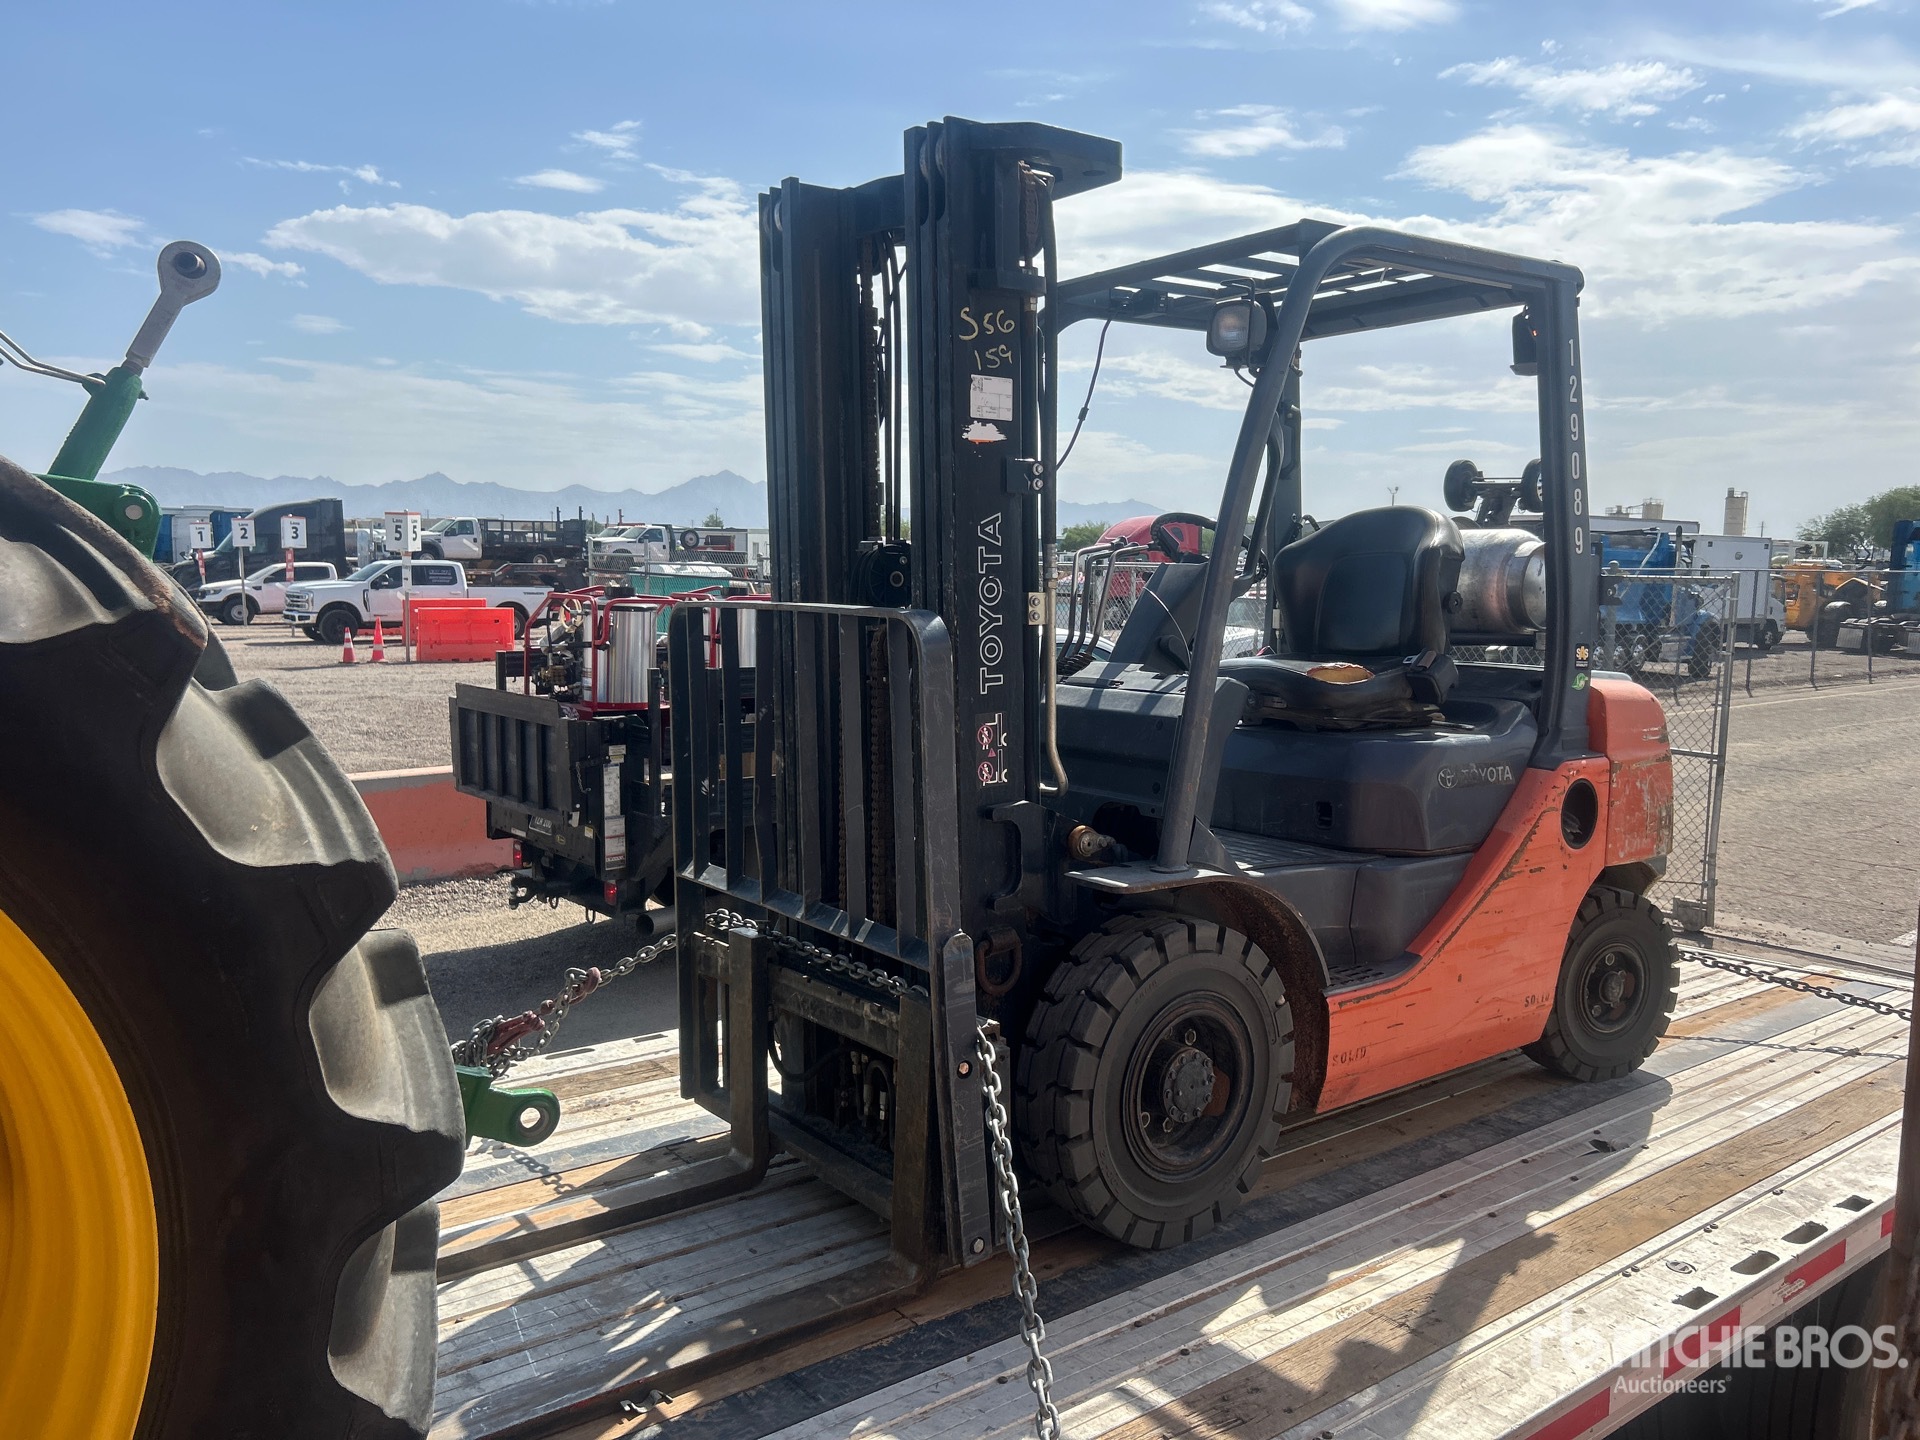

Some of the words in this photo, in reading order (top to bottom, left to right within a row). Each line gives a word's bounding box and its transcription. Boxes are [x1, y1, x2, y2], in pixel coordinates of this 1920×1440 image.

[974, 344, 1013, 371] 159
[1567, 338, 1585, 555] 129089
[197, 531, 204, 542] 1
[240, 527, 248, 539] 2
[291, 526, 299, 540] 3
[394, 525, 403, 541] 5
[412, 525, 418, 541] 5
[977, 511, 1004, 695] TOYOTA
[1332, 1046, 1368, 1067] SOLID
